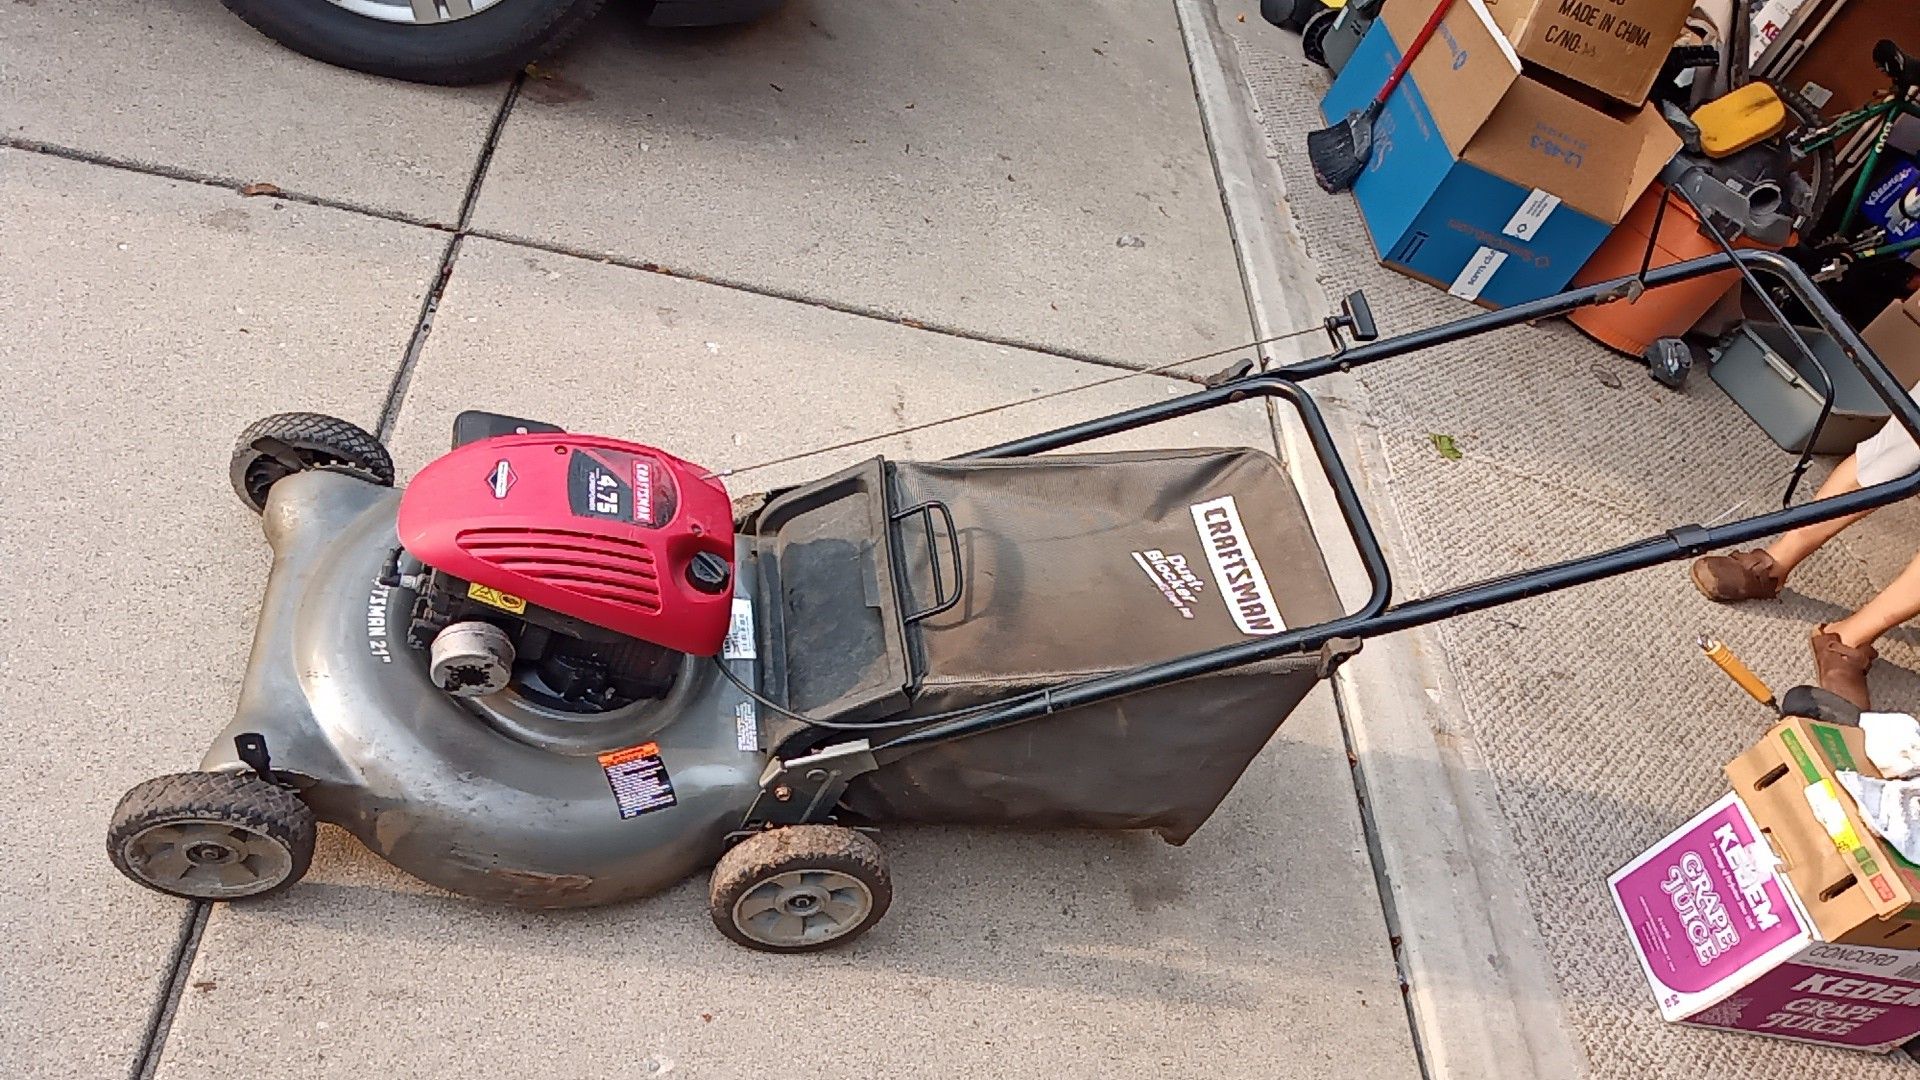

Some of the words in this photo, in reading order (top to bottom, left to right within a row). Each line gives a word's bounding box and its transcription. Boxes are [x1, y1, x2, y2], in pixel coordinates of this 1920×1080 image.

[1558, 0, 1600, 26] MADE
[1598, 13, 1616, 33] IN
[1614, 20, 1651, 48] CHINA
[597, 475, 618, 513] 4.75
[636, 463, 650, 520] CRAFTSMAN
[1143, 549, 1198, 602] Blocker
[1204, 506, 1274, 630] CRAFTSMAN
[367, 576, 390, 636] TSMAN
[1661, 865, 1720, 966] JUICE
[1680, 851, 1740, 951] GRAPE
[1809, 946, 1898, 966] CONCORD
[1757, 1013, 1863, 1035] JUICE
[1784, 998, 1888, 1022] GRAPE
